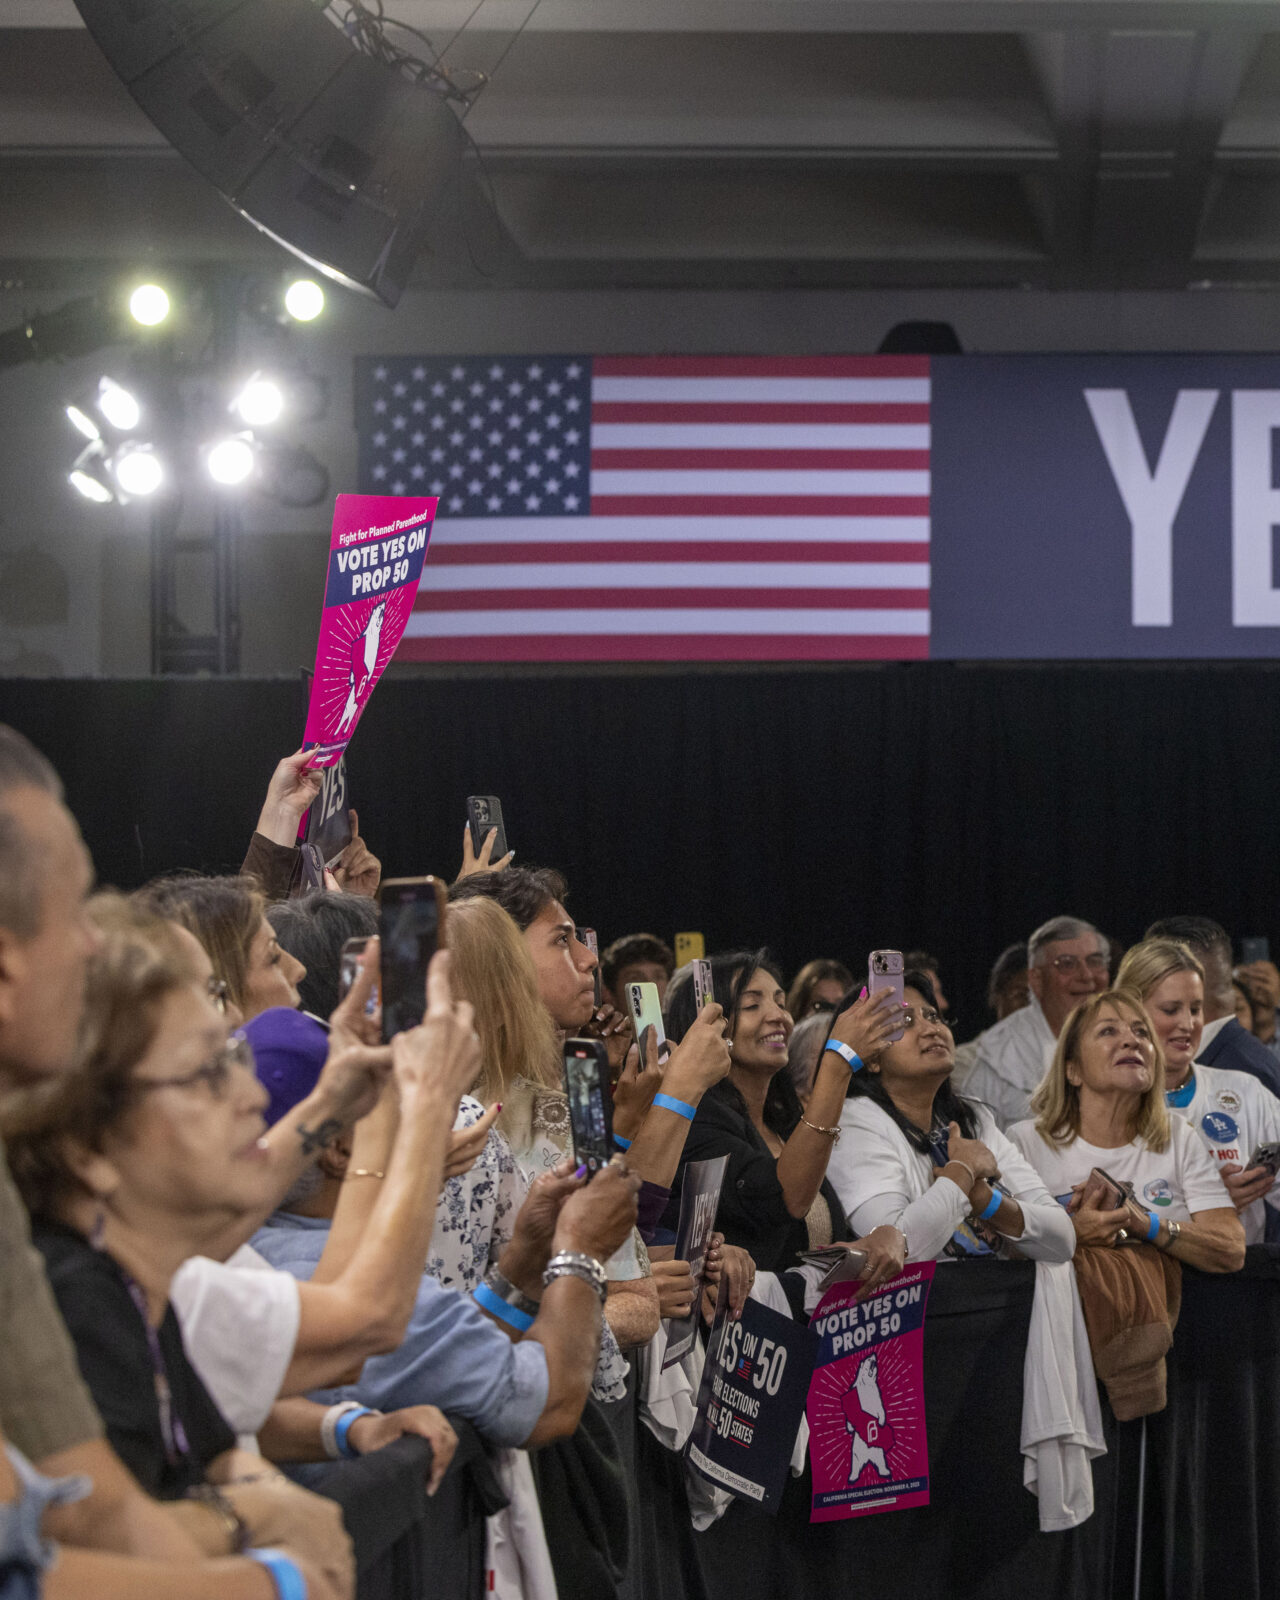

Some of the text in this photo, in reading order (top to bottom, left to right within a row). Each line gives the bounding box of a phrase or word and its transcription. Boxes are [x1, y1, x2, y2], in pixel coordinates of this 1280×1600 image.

[339, 509, 428, 546] Fight for Planned Parenthood
[337, 527, 427, 573] VOTE YES ON
[351, 558, 409, 596] PROP 50
[319, 754, 347, 827] YES
[1217, 1149, 1239, 1161] HOT
[879, 1270, 922, 1291] Parenthood
[815, 1306, 859, 1338] VOTE
[861, 1295, 893, 1320] YES
[895, 1284, 922, 1309] ON
[832, 1312, 901, 1356] PROP 50
[742, 1331, 758, 1359] ON
[752, 1338, 788, 1396] 50
[721, 1382, 760, 1419] ELECTIONS
[716, 1406, 733, 1439] 50
[730, 1420, 754, 1444] STATES
[724, 1471, 750, 1491] Democratic
